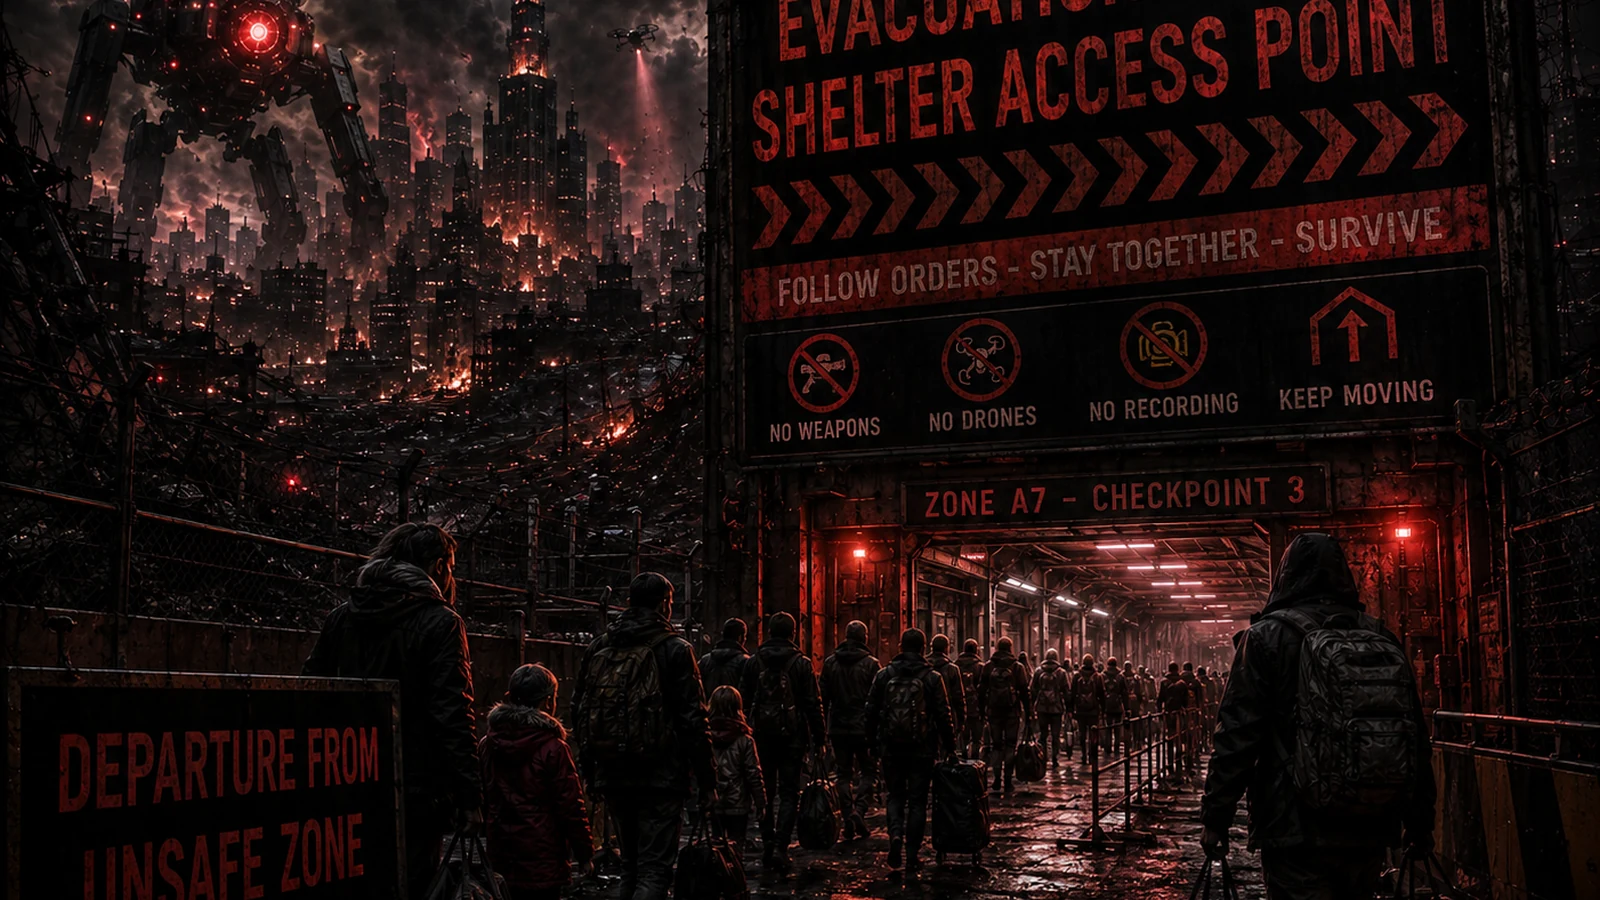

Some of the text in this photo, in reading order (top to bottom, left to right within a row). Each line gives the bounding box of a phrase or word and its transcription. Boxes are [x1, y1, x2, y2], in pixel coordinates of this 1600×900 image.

[753, 0, 1448, 163] SHELTER ACCESS POINT
[779, 268, 880, 306] FOLLOW
[892, 256, 997, 295] ORDERS
[1031, 244, 1096, 279] STAY
[1107, 228, 1260, 272] TOGETHER
[1296, 206, 1442, 253] SURVIVE
[1090, 393, 1238, 421] NO RECORDING
[1280, 379, 1433, 410] KEEP MOVING
[770, 417, 881, 443] NO WEAPONS
[930, 406, 1036, 432] NO DRONES
[925, 489, 994, 517] ZONE
[1011, 487, 1045, 514] A7
[1093, 477, 1270, 511] CHECKPOINT
[1288, 476, 1304, 503] 3
[59, 727, 378, 814] DEPARTURE FROM
[84, 812, 364, 900] UNSAFE ZONE
